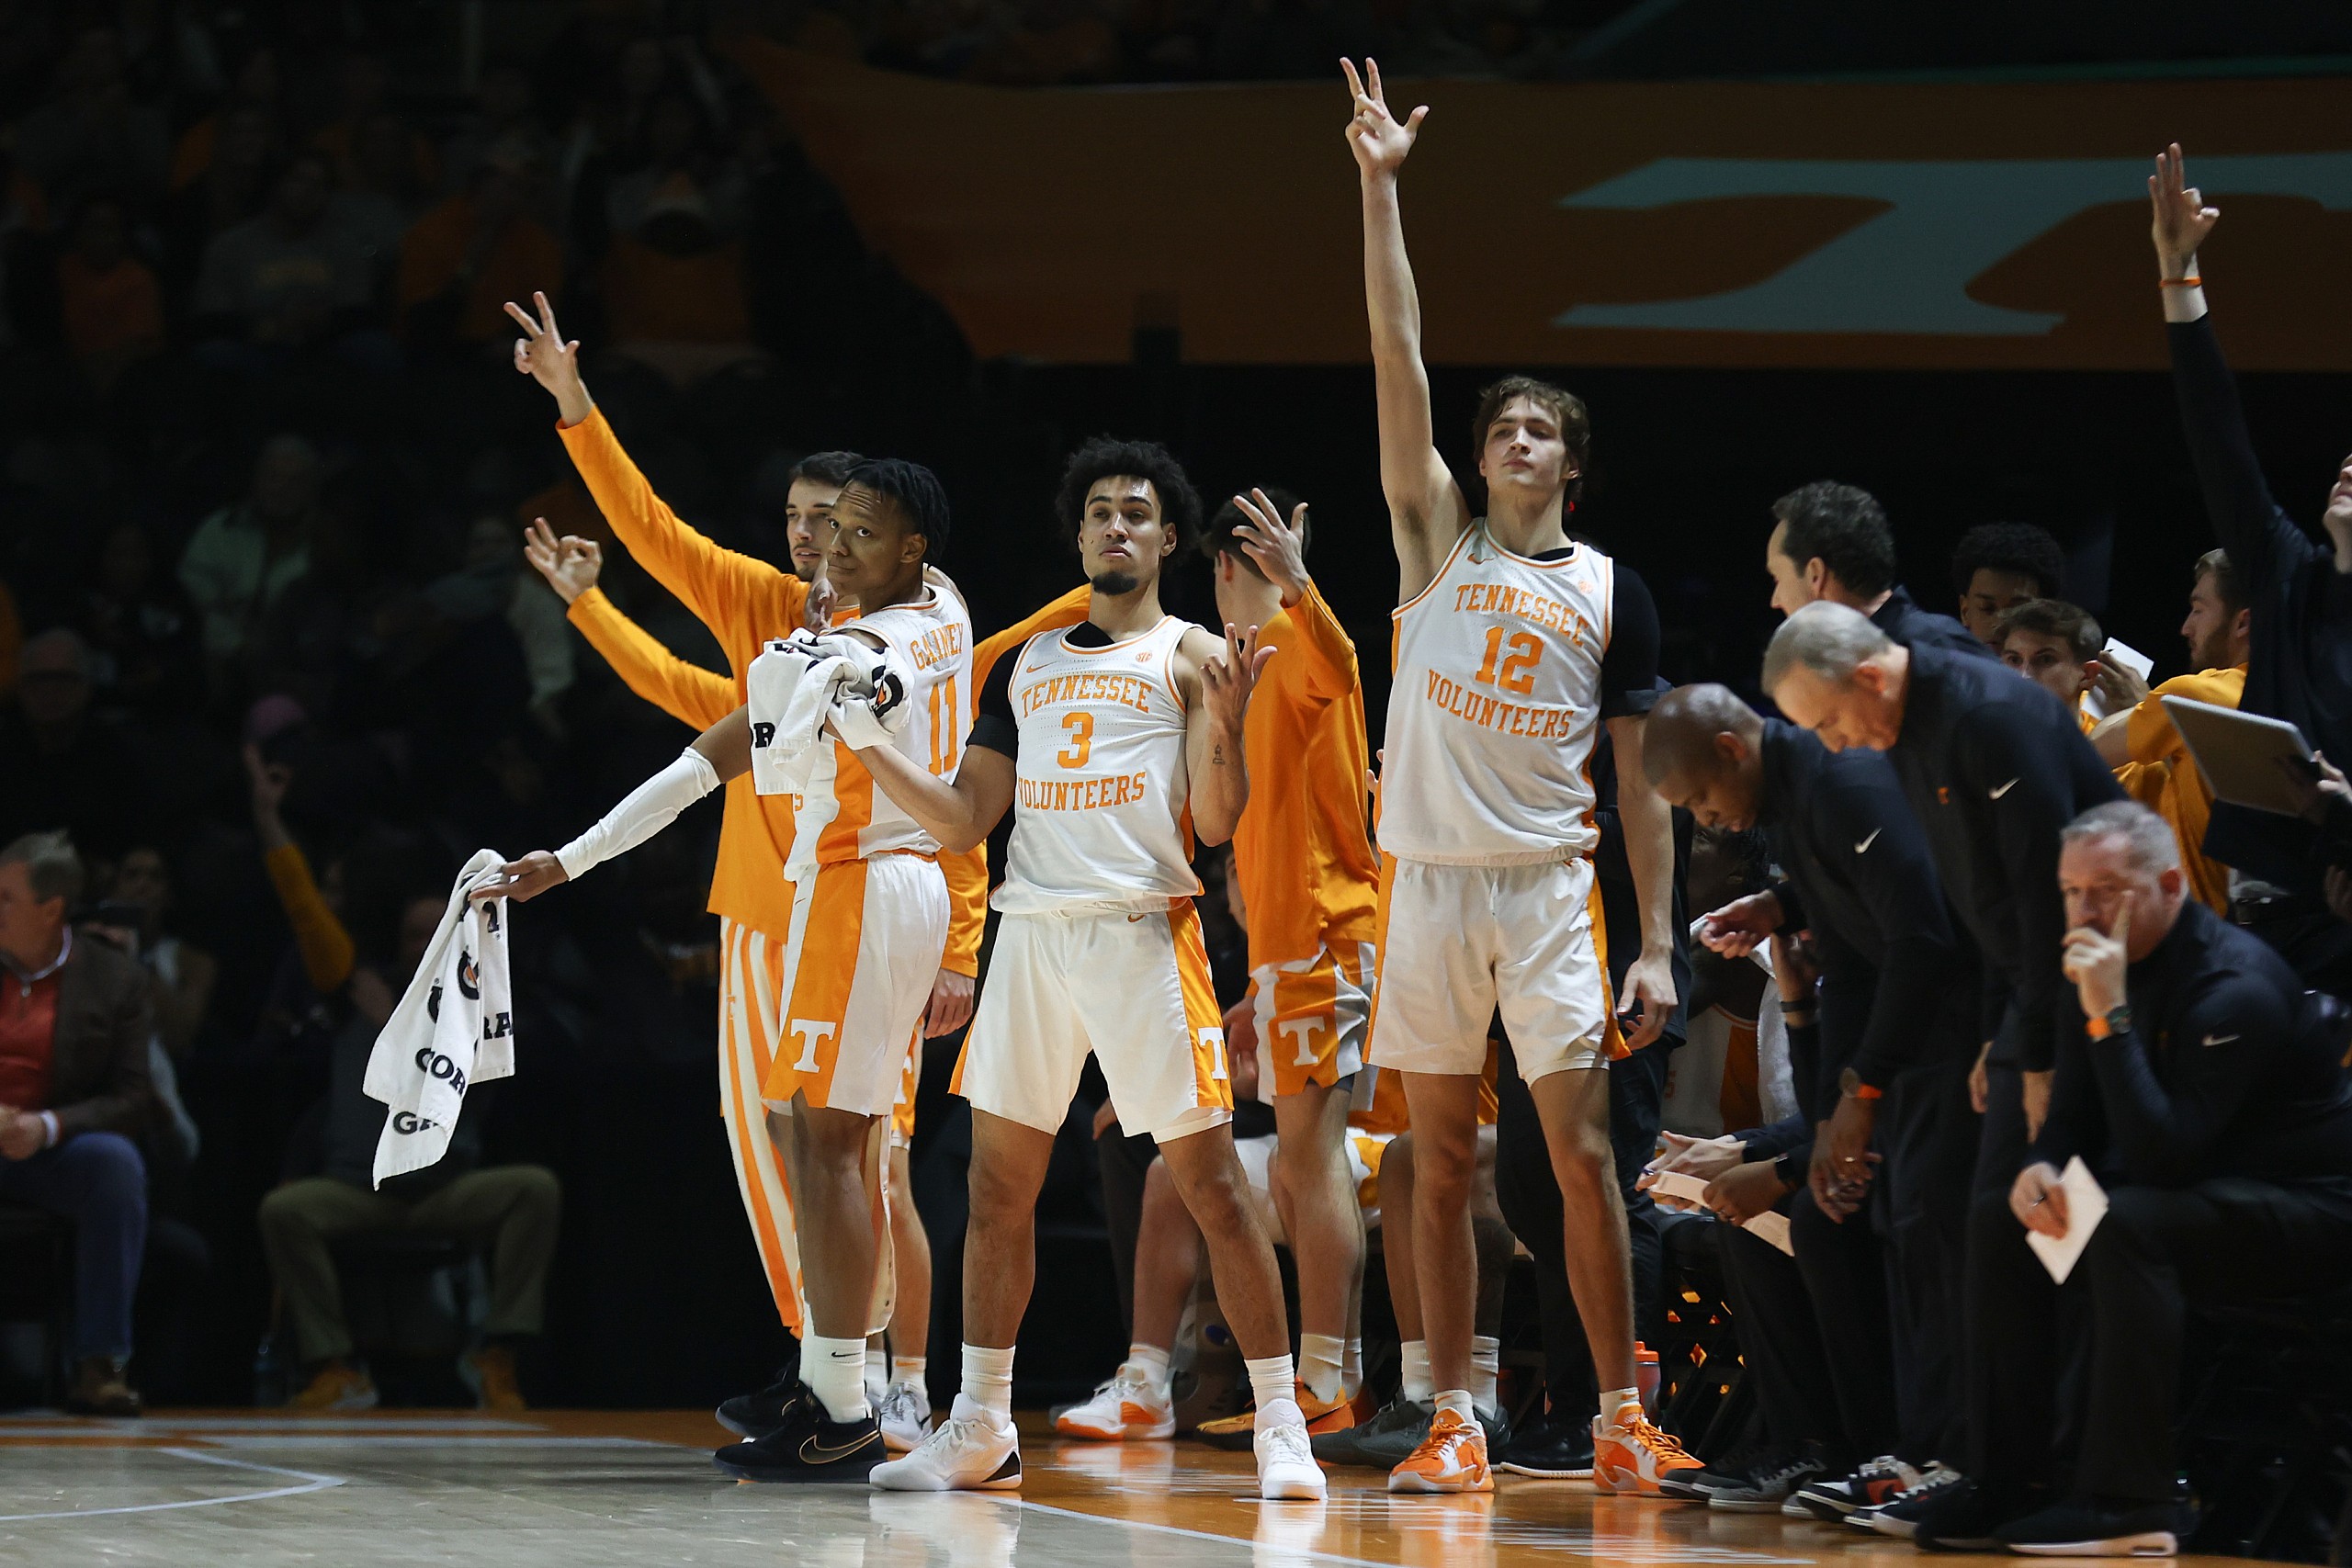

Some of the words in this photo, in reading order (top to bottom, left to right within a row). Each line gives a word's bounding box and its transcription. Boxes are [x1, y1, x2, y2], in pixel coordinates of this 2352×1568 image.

[1453, 583, 1589, 648] TENNESSEE
[1475, 626, 1545, 695] 12
[1021, 674, 1153, 718] TENNESSEE
[1427, 668, 1575, 739] VOLUNTEERS
[928, 675, 958, 776] 11
[1057, 712, 1094, 769] 3
[790, 1019, 837, 1074] T
[1197, 1027, 1228, 1079] T
[1277, 1016, 1326, 1066] T
